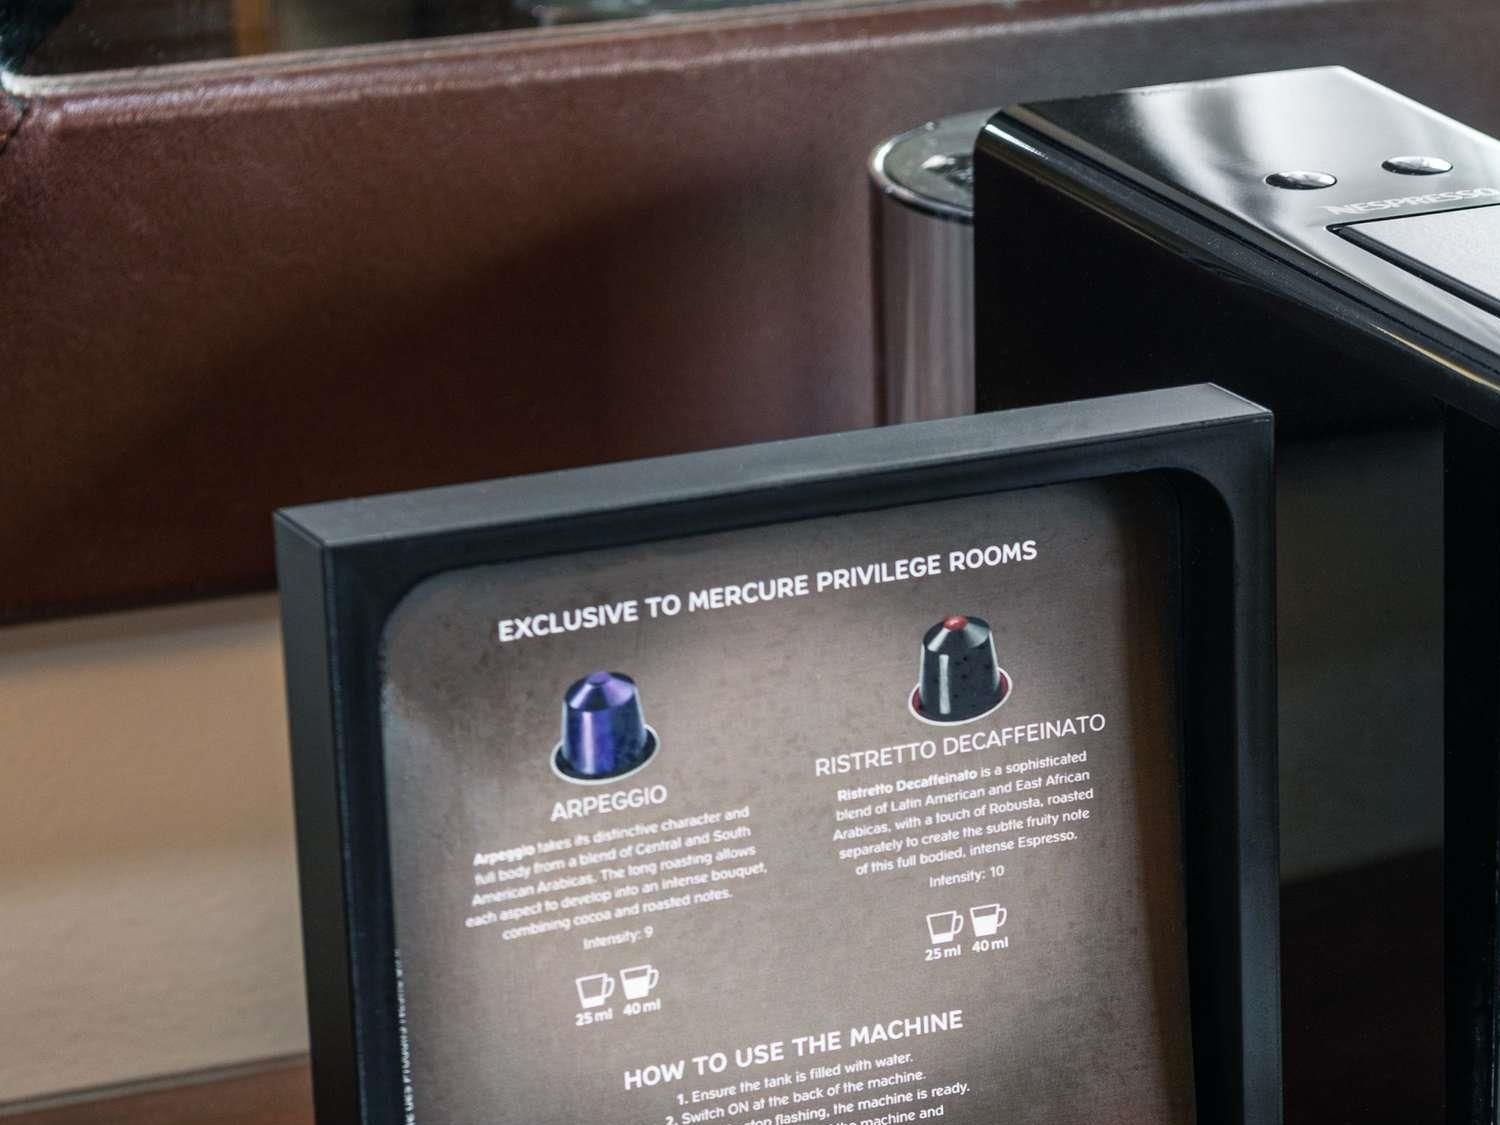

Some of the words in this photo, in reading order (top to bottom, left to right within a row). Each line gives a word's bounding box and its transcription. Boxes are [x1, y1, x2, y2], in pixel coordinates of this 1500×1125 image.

[1318, 187, 1500, 215] NESPRESSO
[498, 600, 638, 642] EXCLUSIVE
[644, 593, 681, 617] TO
[688, 574, 809, 611] MERCURE
[816, 553, 941, 592] PRIVILEGE
[948, 539, 1037, 572] ROOMS
[815, 740, 936, 776] RISTRETTO
[943, 713, 1105, 755] DECAFFEINATO
[835, 804, 871, 821] blend
[874, 801, 887, 814] of
[890, 798, 921, 811] Latin
[924, 787, 985, 806] American
[987, 781, 1012, 795] and
[1015, 776, 1042, 791] East
[1045, 771, 1090, 786] African
[837, 783, 893, 801] Ristretto
[895, 769, 977, 791] Decaffeinato
[980, 767, 991, 777] is
[993, 765, 1002, 775] a
[1005, 749, 1087, 774] sophisticated
[549, 784, 667, 821] ARPEGGIO
[832, 823, 891, 840] Arabicas,
[894, 816, 921, 829] with
[924, 815, 932, 825] a
[935, 807, 970, 823] touch
[973, 804, 986, 817] of
[988, 797, 1043, 814] Robusta,
[1047, 787, 1094, 805] roasted
[838, 839, 903, 859] separately
[905, 836, 918, 847] to
[920, 829, 960, 844] create
[962, 826, 983, 837] the
[985, 819, 1023, 834] subtle
[1026, 813, 1059, 827] fruity
[1061, 807, 1090, 822] note
[855, 862, 868, 875] of
[870, 859, 894, 872] this
[896, 854, 916, 868] full
[919, 846, 966, 864] bodied,
[969, 840, 1014, 856] intense
[1017, 830, 1077, 848] Espresso.
[929, 869, 985, 887] Intensity:
[989, 864, 1004, 877] 10
[924, 947, 941, 961] 25
[943, 943, 961, 957] ml
[971, 939, 989, 952] 40
[990, 935, 1008, 949] ml
[575, 1011, 593, 1026] 25
[594, 1007, 613, 1021] ml
[622, 1001, 641, 1015] 40
[642, 997, 661, 1012] ml
[623, 1059, 684, 1090] HOW
[691, 1052, 727, 1075] TO
[735, 1041, 784, 1067] USE
[791, 1030, 841, 1056] THE
[850, 1009, 963, 1046] MACHINE
[676, 1093, 688, 1105] 1.
[691, 1085, 736, 1102] Ensure
[739, 1080, 760, 1092] the
[763, 1073, 792, 1088] tank
[795, 1071, 806, 1082] is
[809, 1063, 841, 1079] filled
[844, 1058, 872, 1073] with
[874, 1052, 913, 1067] water.
[681, 1106, 724, 1124] Switch
[727, 1100, 749, 1115] ON
[752, 1097, 765, 1110] at
[768, 1095, 789, 1107] the
[792, 1087, 824, 1102] back
[826, 1082, 840, 1096] of
[842, 1081, 864, 1093] the
[867, 1071, 926, 1089] machine.
[774, 1108, 830, 1125] flashing,
[833, 1102, 854, 1115] the
[857, 1091, 913, 1110] machine
[916, 1088, 928, 1099] is
[930, 1081, 970, 1097] ready.
[918, 1104, 944, 1118] and
